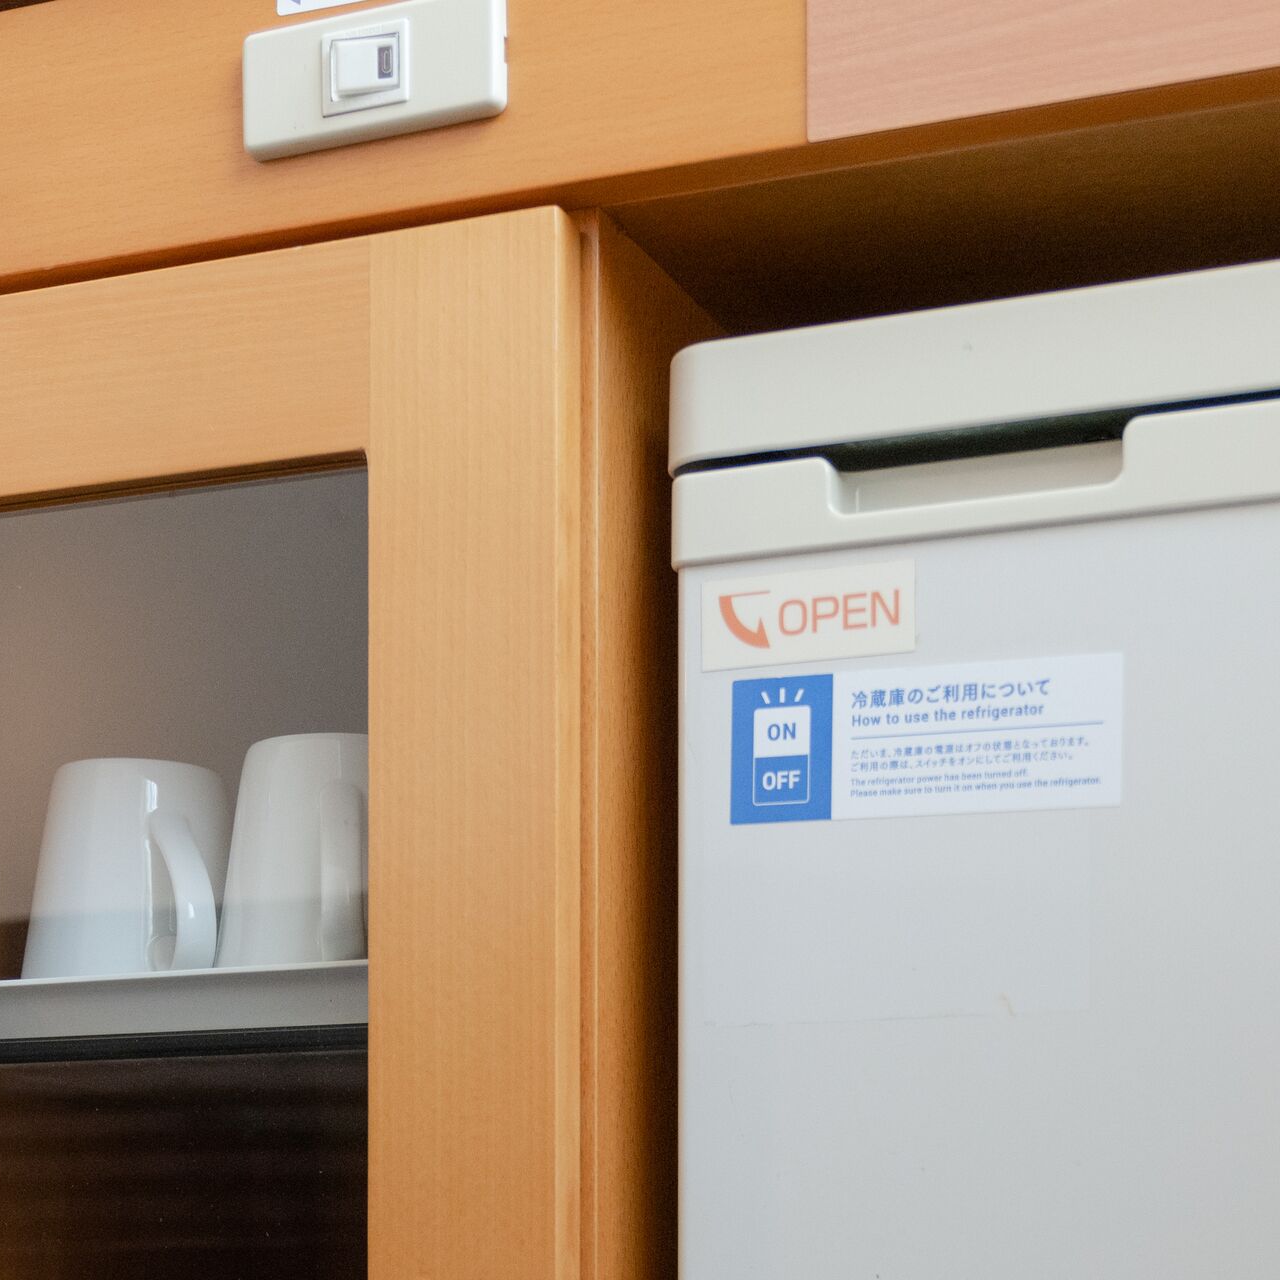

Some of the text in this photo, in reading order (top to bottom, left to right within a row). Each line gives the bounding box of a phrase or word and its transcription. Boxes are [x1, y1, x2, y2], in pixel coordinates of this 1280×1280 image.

[778, 588, 900, 636] OPEN
[851, 678, 1051, 709] 冷蔵庫のご利用について
[851, 703, 1044, 727] How to use the refrigerator
[767, 722, 796, 741] ON
[762, 770, 801, 791] OFF
[850, 788, 877, 798] Please
[880, 787, 901, 796] make
[904, 787, 922, 795] sure
[924, 785, 932, 794] to
[934, 784, 951, 793] turn
[954, 784, 960, 792] it
[962, 784, 972, 792] on
[975, 781, 997, 790] when
[1000, 782, 1014, 792] you
[1016, 780, 1032, 788] use
[1035, 778, 1048, 788] the
[851, 777, 865, 787] The
[867, 775, 914, 788] refrigerator
[917, 775, 942, 784] power
[944, 772, 959, 780] has
[962, 771, 981, 780] been
[984, 769, 1012, 779] turned
